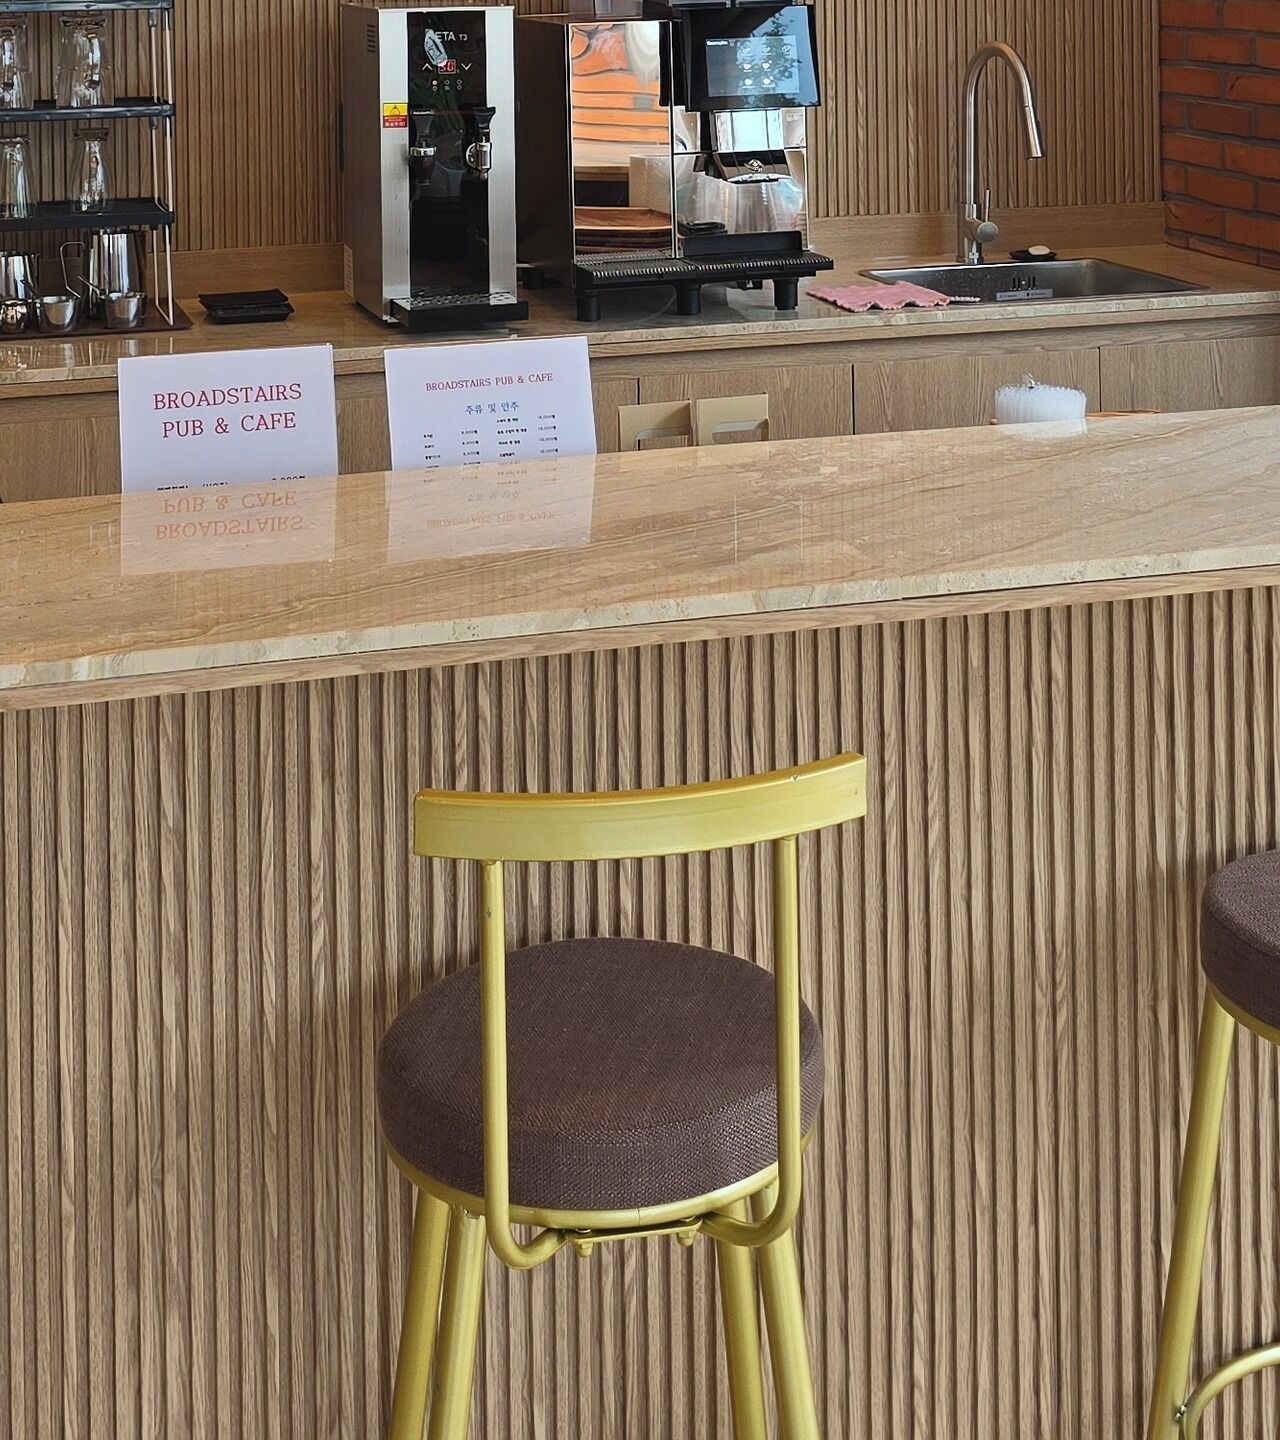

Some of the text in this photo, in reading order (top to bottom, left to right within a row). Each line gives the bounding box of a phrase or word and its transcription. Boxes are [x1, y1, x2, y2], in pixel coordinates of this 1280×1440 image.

[425, 372, 554, 392] BROADSTAIRS PUB & CAFE
[153, 383, 302, 410] BROADSTAIRS
[465, 404, 483, 416] 주류
[501, 400, 519, 412] 안주
[162, 411, 296, 438] PUB & CAFE
